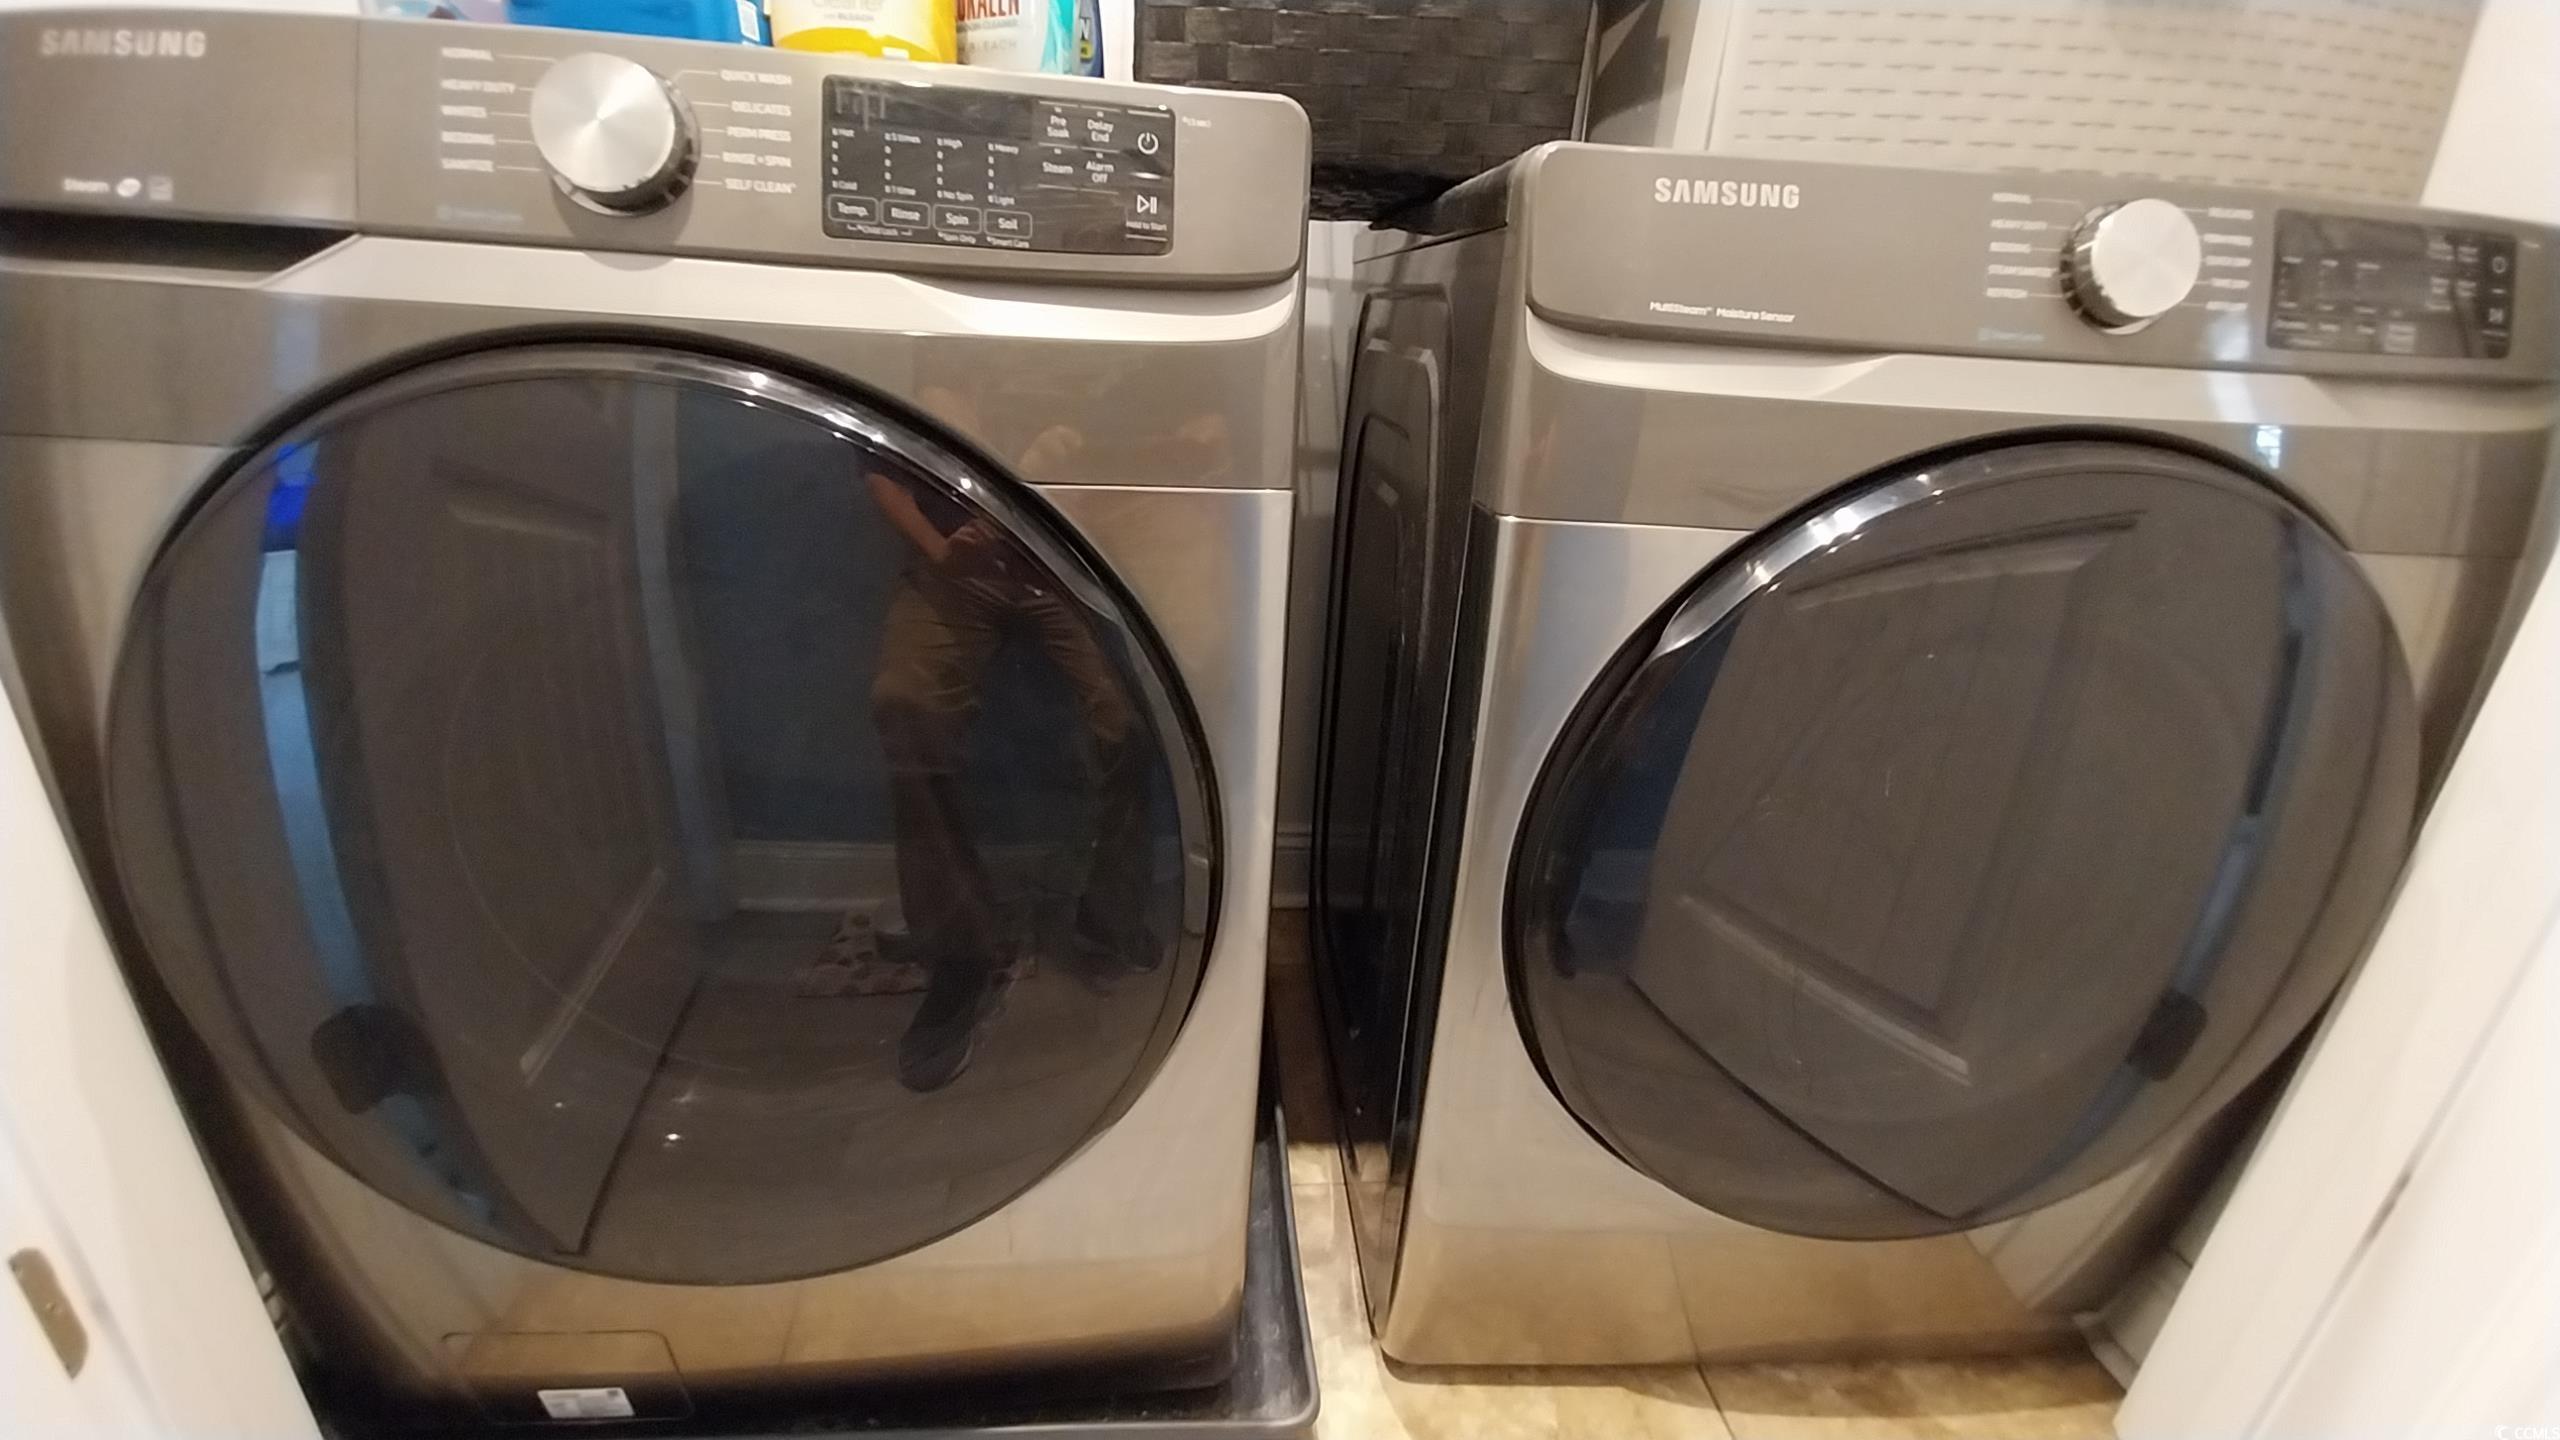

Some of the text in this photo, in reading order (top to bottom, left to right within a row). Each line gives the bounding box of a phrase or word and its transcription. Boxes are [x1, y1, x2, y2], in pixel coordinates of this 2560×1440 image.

[41, 29, 206, 58] SAMSUNG
[720, 69, 792, 85] QUICK WASH
[441, 79, 516, 95] HEAVY DUTY
[731, 101, 792, 117] DELICATES
[1050, 115, 1067, 127] Pre
[1087, 119, 1114, 133] Delay
[726, 126, 792, 142] PERM PRESS
[1047, 126, 1070, 138] Soak
[1091, 130, 1110, 143] End
[943, 138, 963, 150] High
[722, 152, 757, 166] RINSE
[764, 155, 792, 168] SPIN
[1086, 160, 1114, 173] Alarm
[1042, 161, 1074, 174] Steam
[725, 178, 752, 191] SELF
[1091, 172, 1108, 183] Off
[1654, 177, 1800, 209] SAMSUNG
[891, 207, 921, 221] Rinse
[945, 212, 969, 226] Spin
[998, 217, 1018, 230] Soil
[1150, 221, 1168, 231] Start
[1716, 307, 1796, 323] Moisture Sensor
